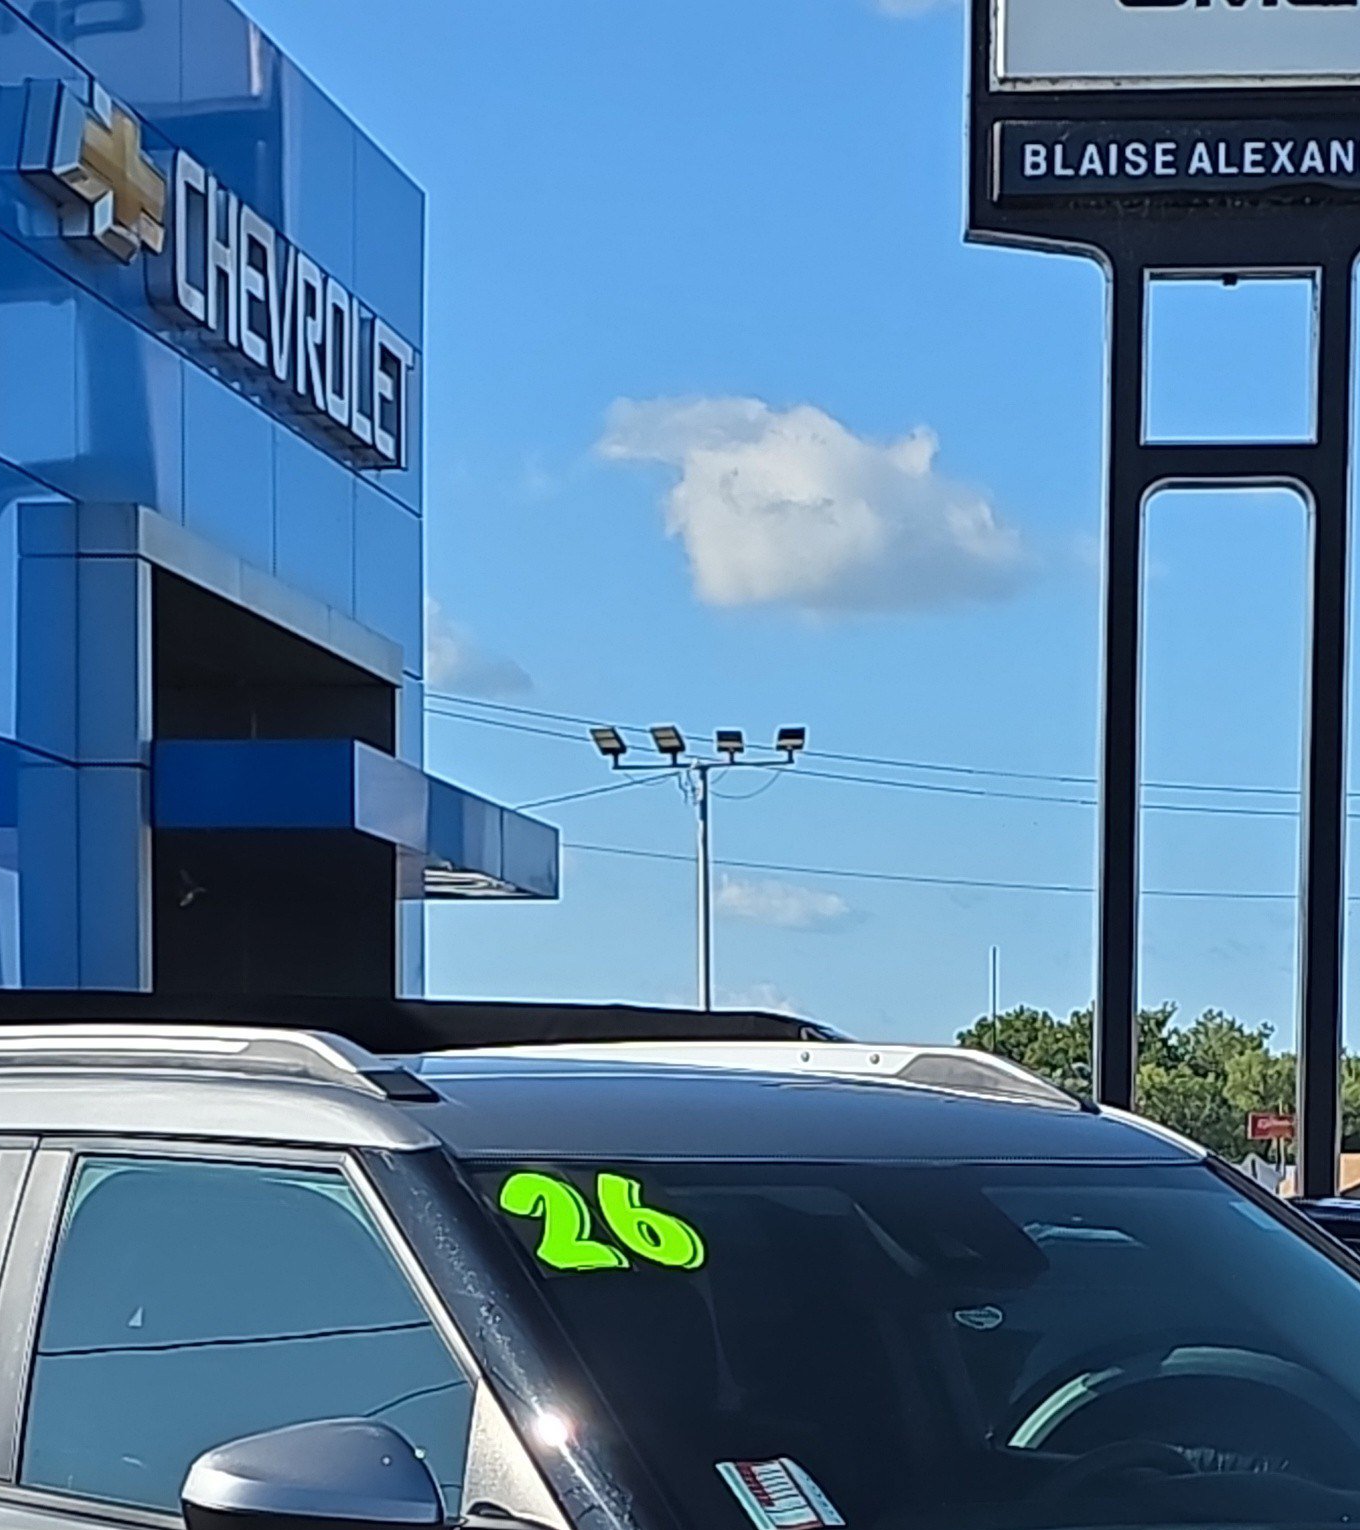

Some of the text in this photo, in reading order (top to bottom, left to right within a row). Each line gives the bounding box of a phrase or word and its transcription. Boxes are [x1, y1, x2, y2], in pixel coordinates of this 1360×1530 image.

[1023, 141, 1176, 176] BLAISE
[172, 148, 414, 470] CHEVROLET
[500, 1172, 704, 1270] 26
